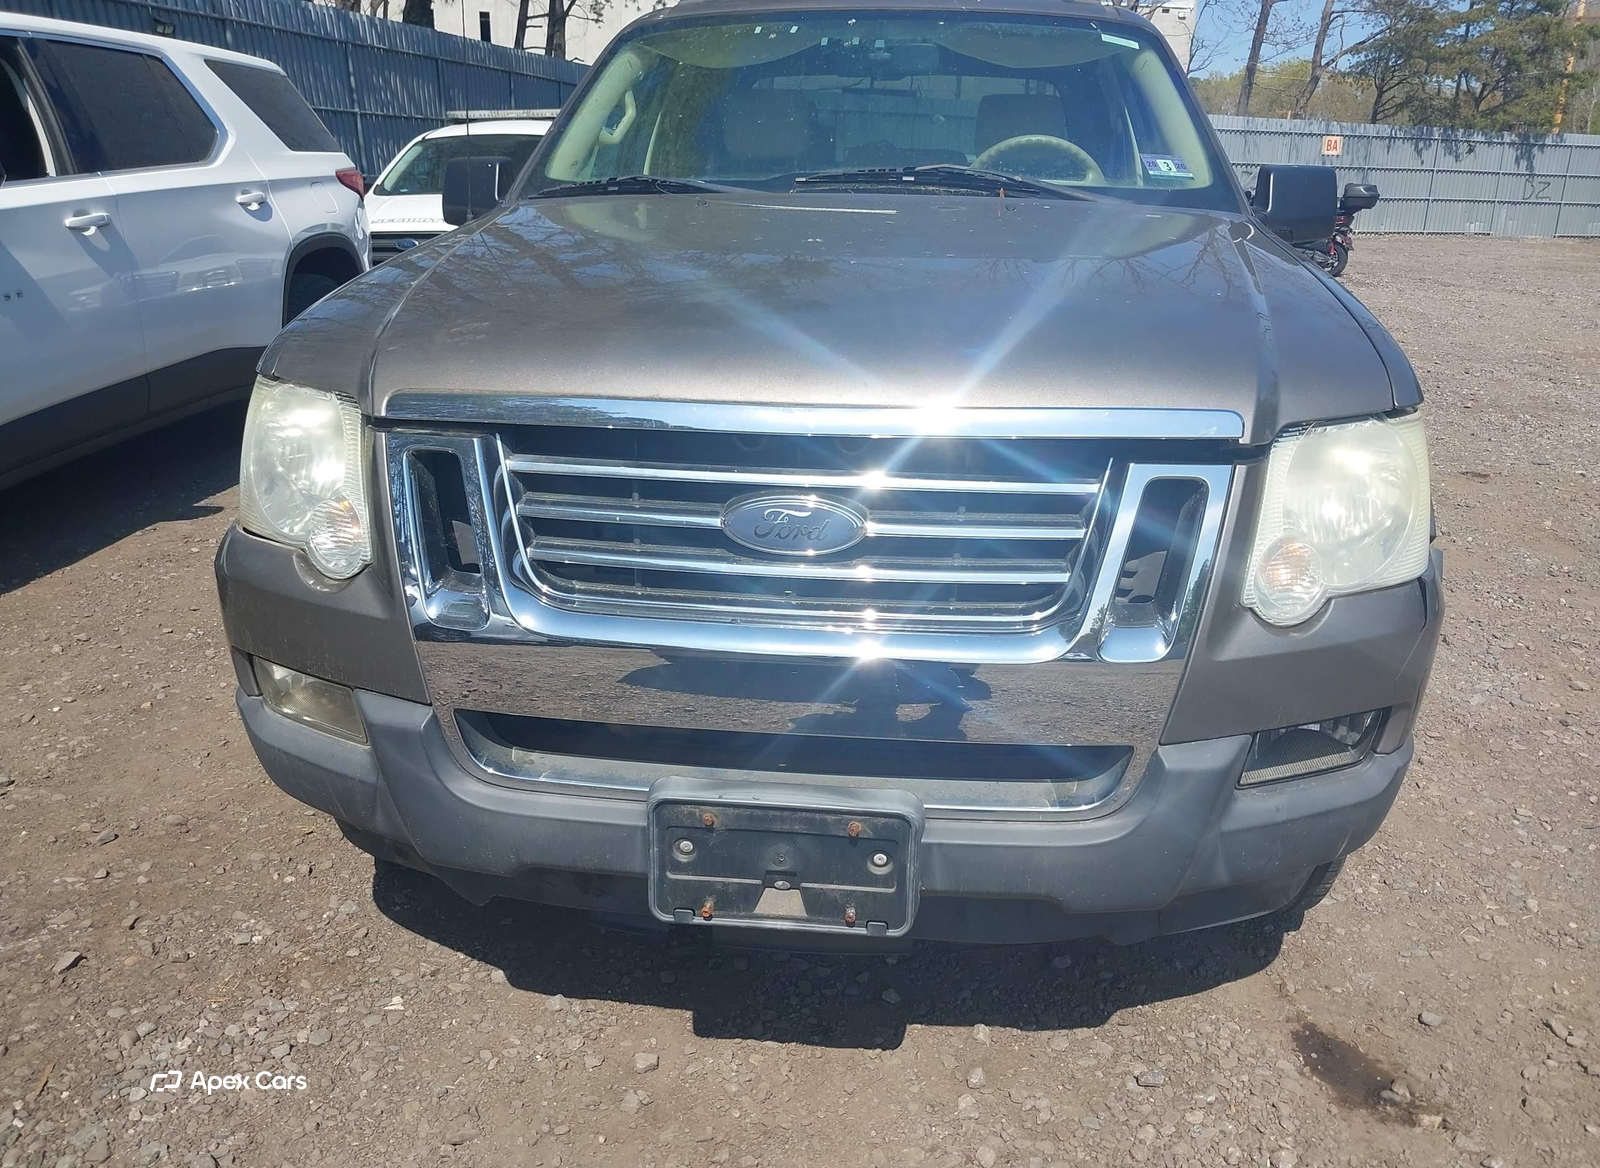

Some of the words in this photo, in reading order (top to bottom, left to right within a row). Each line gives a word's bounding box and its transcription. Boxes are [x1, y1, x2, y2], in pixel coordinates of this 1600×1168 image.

[1326, 139, 1338, 151] BA
[1146, 160, 1157, 168] 20
[1163, 161, 1172, 171] 3
[753, 508, 831, 541] Ford
